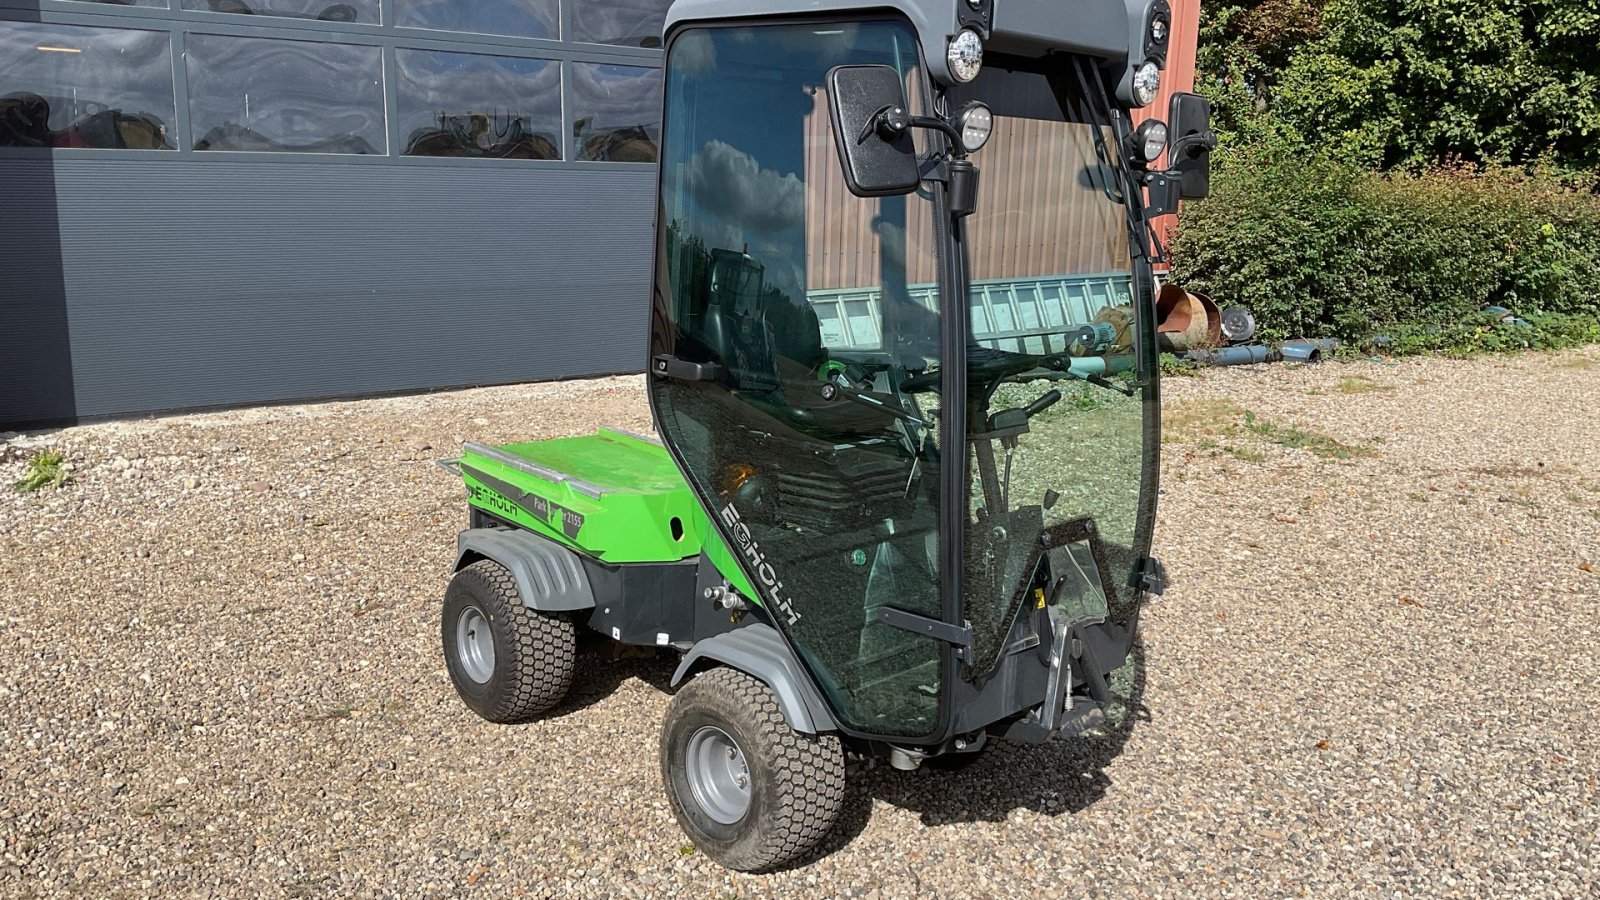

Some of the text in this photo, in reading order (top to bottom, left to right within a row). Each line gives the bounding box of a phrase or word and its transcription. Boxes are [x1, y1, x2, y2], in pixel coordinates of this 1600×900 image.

[534, 497, 547, 512] Park
[567, 512, 582, 527] 2155
[721, 502, 802, 626] EGHOLM
